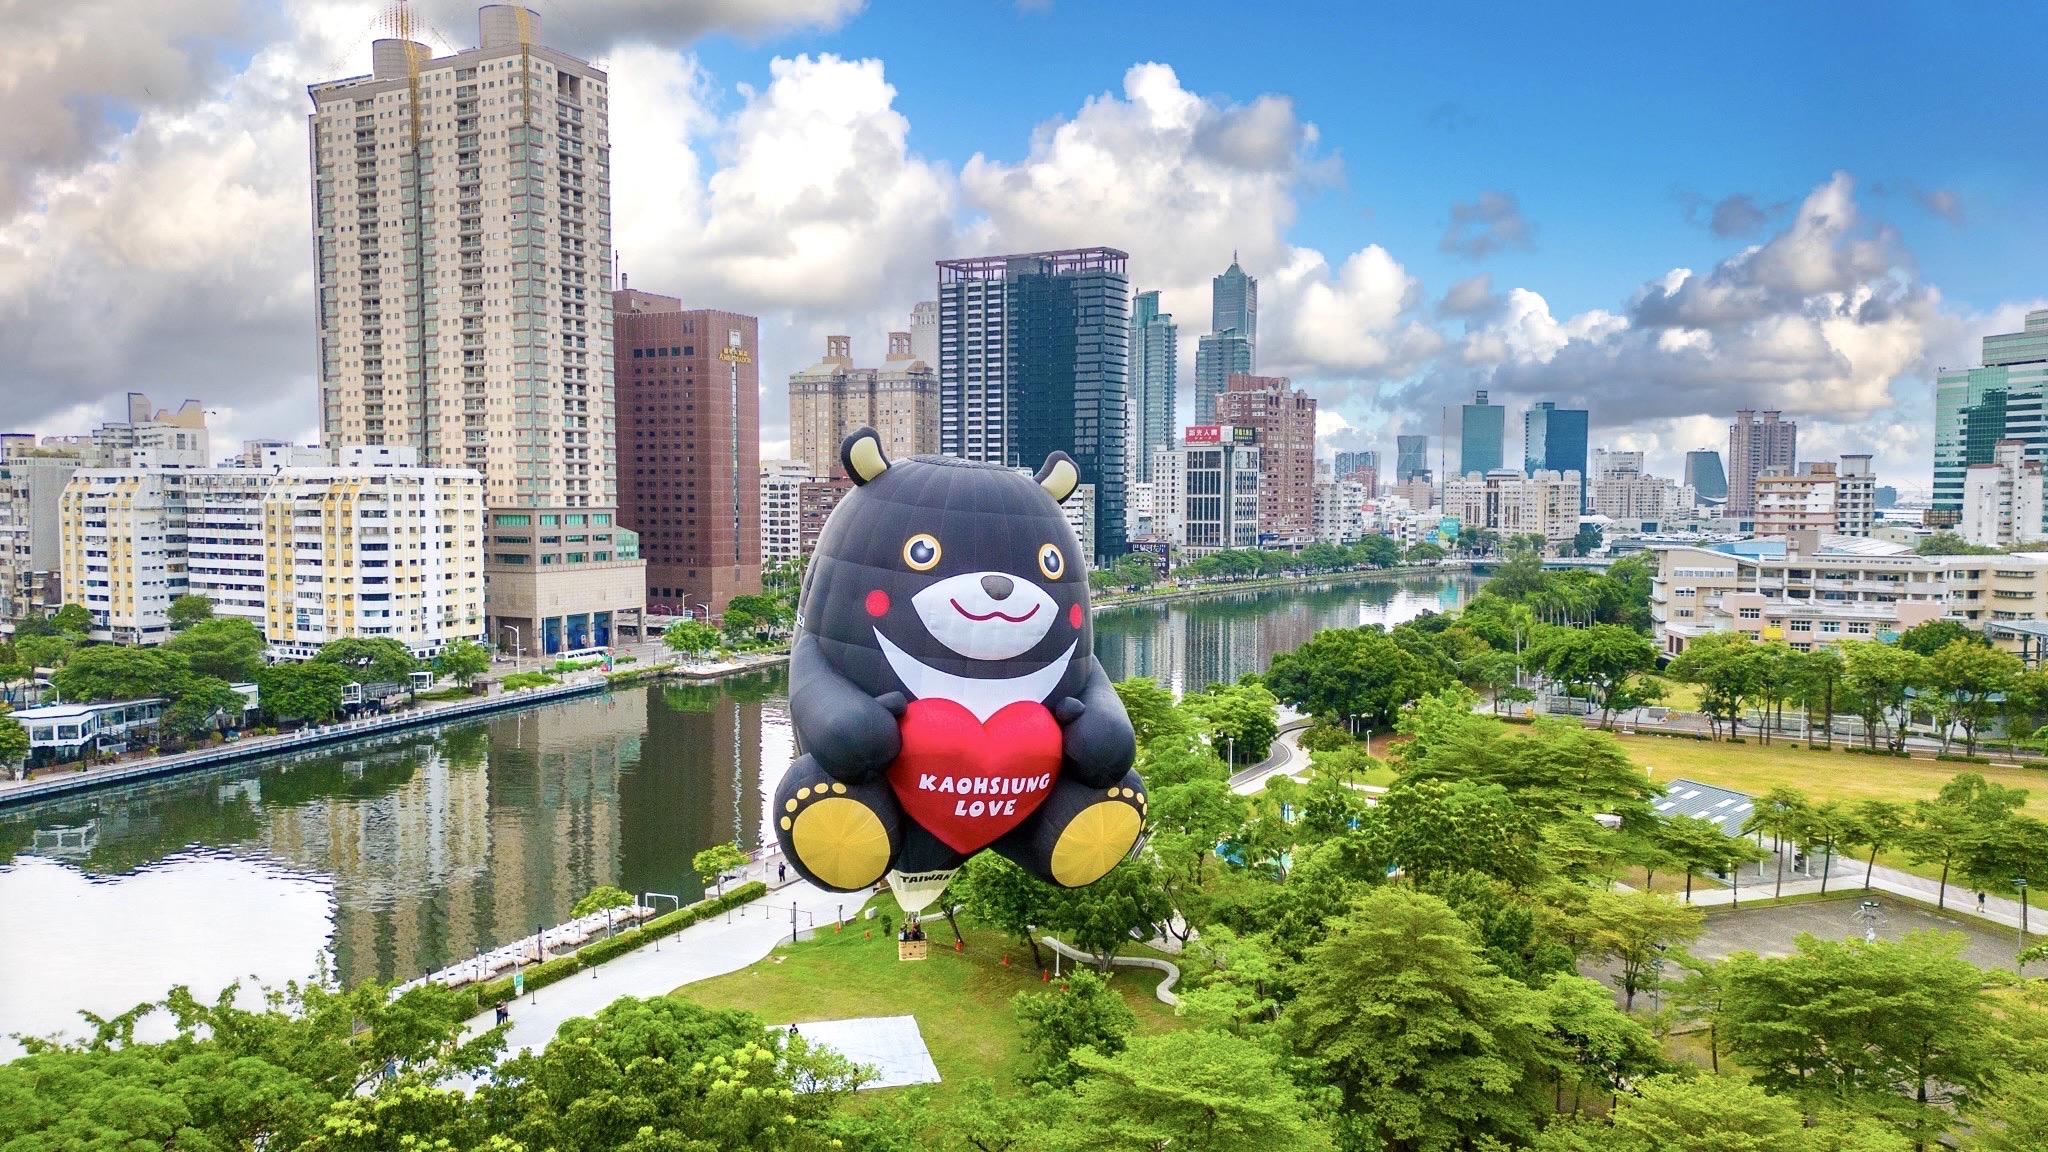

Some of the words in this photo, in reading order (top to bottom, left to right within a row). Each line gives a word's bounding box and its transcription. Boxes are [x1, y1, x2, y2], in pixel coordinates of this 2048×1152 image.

[919, 773, 1050, 795] KAOHSIUNG
[954, 799, 1017, 817] LOVE
[900, 873, 952, 883] TAIWAN
